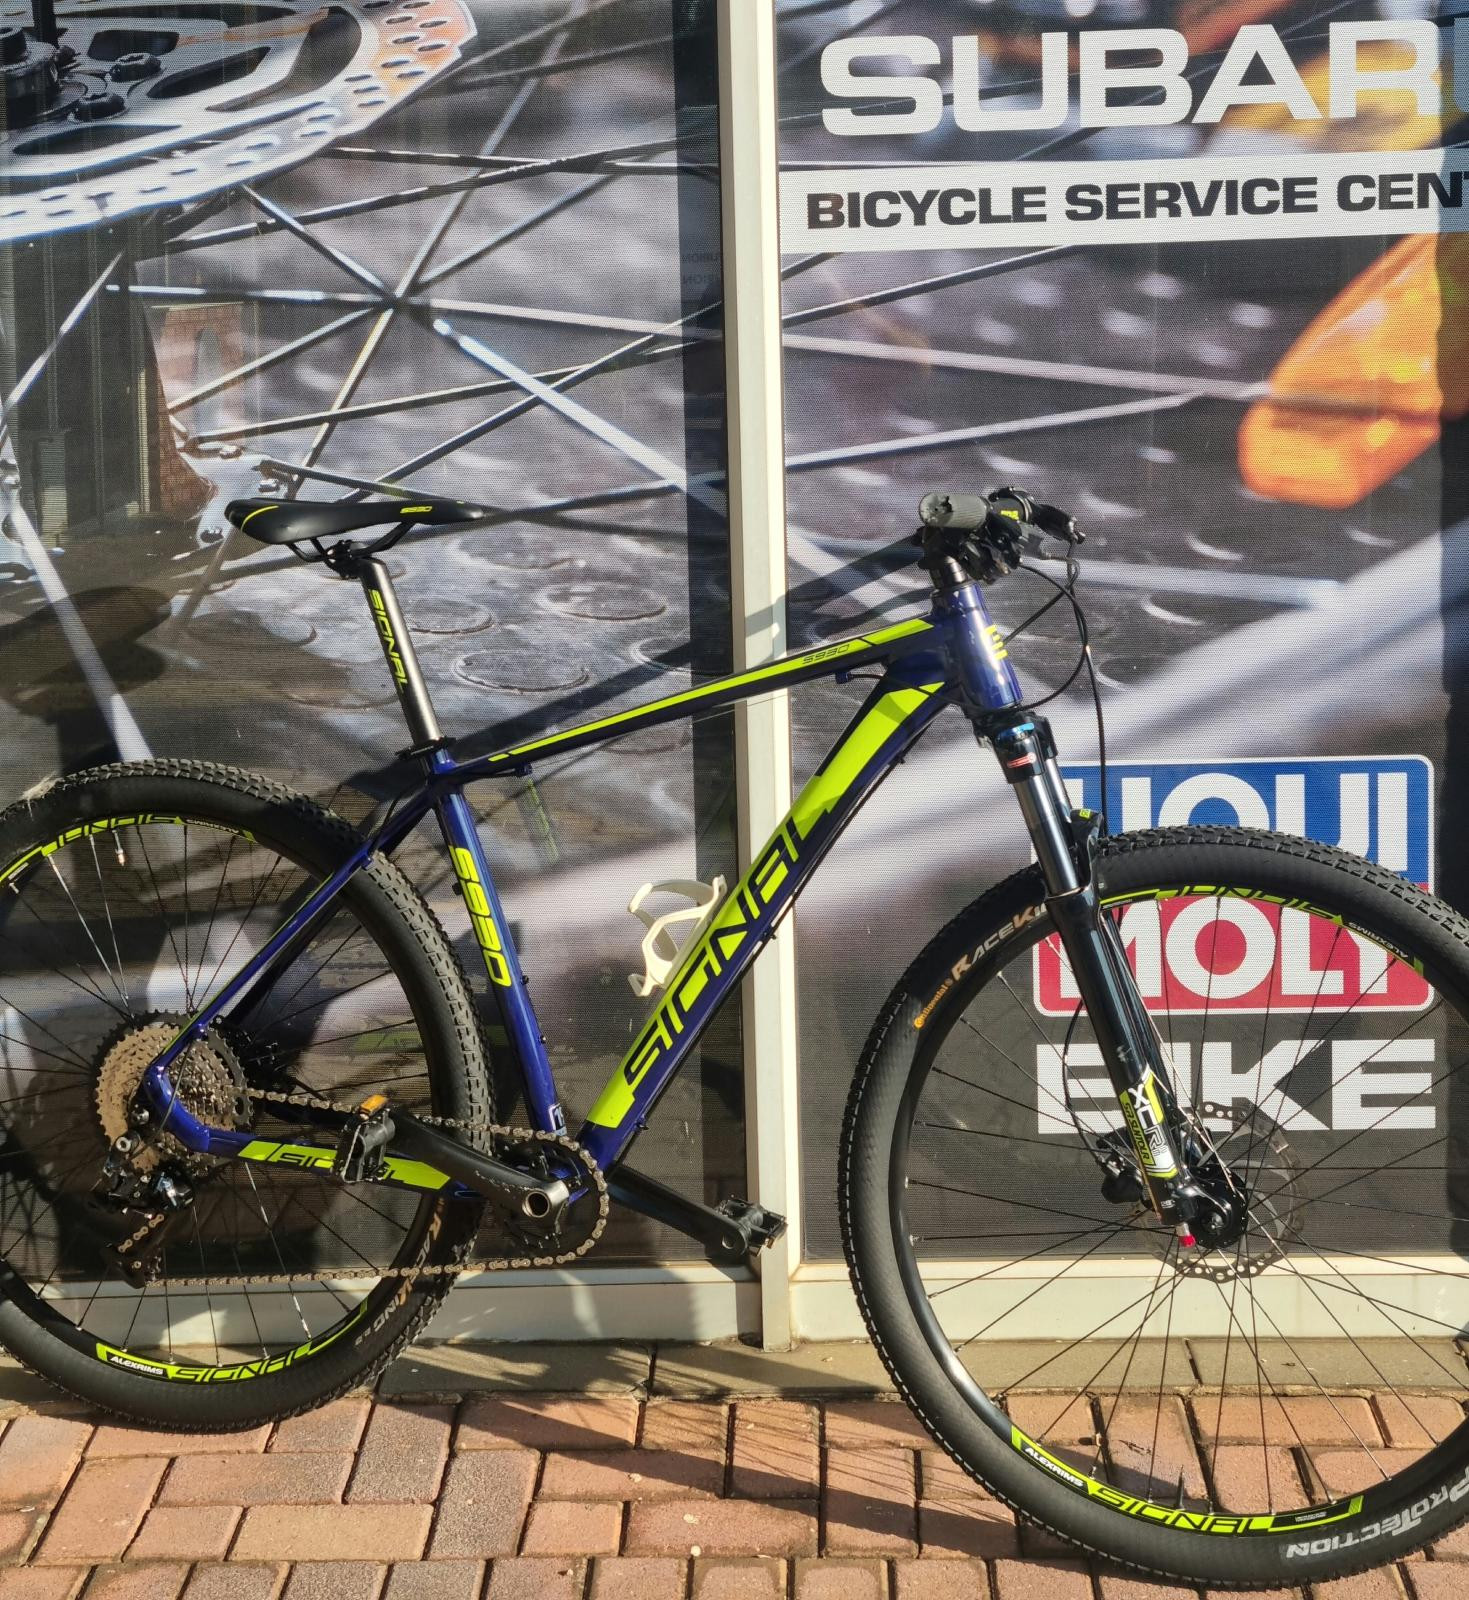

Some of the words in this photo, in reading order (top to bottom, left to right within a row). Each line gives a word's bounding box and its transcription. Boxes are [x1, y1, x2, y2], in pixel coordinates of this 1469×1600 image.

[820, 17, 1469, 137] SUBAR
[806, 186, 1047, 229] BICYCLE
[1065, 177, 1318, 221] SERVICE
[1336, 170, 1469, 210] CEN
[368, 588, 408, 694] SIGNAL
[622, 808, 832, 1088] SIGNAL
[1036, 1038, 1436, 1135] BIKE
[280, 1151, 406, 1183] SIGL
[110, 1355, 164, 1375] ALEXRIMS
[1024, 1447, 1085, 1488] ALEXRIMS
[1092, 1486, 1274, 1534] SIGNAL
